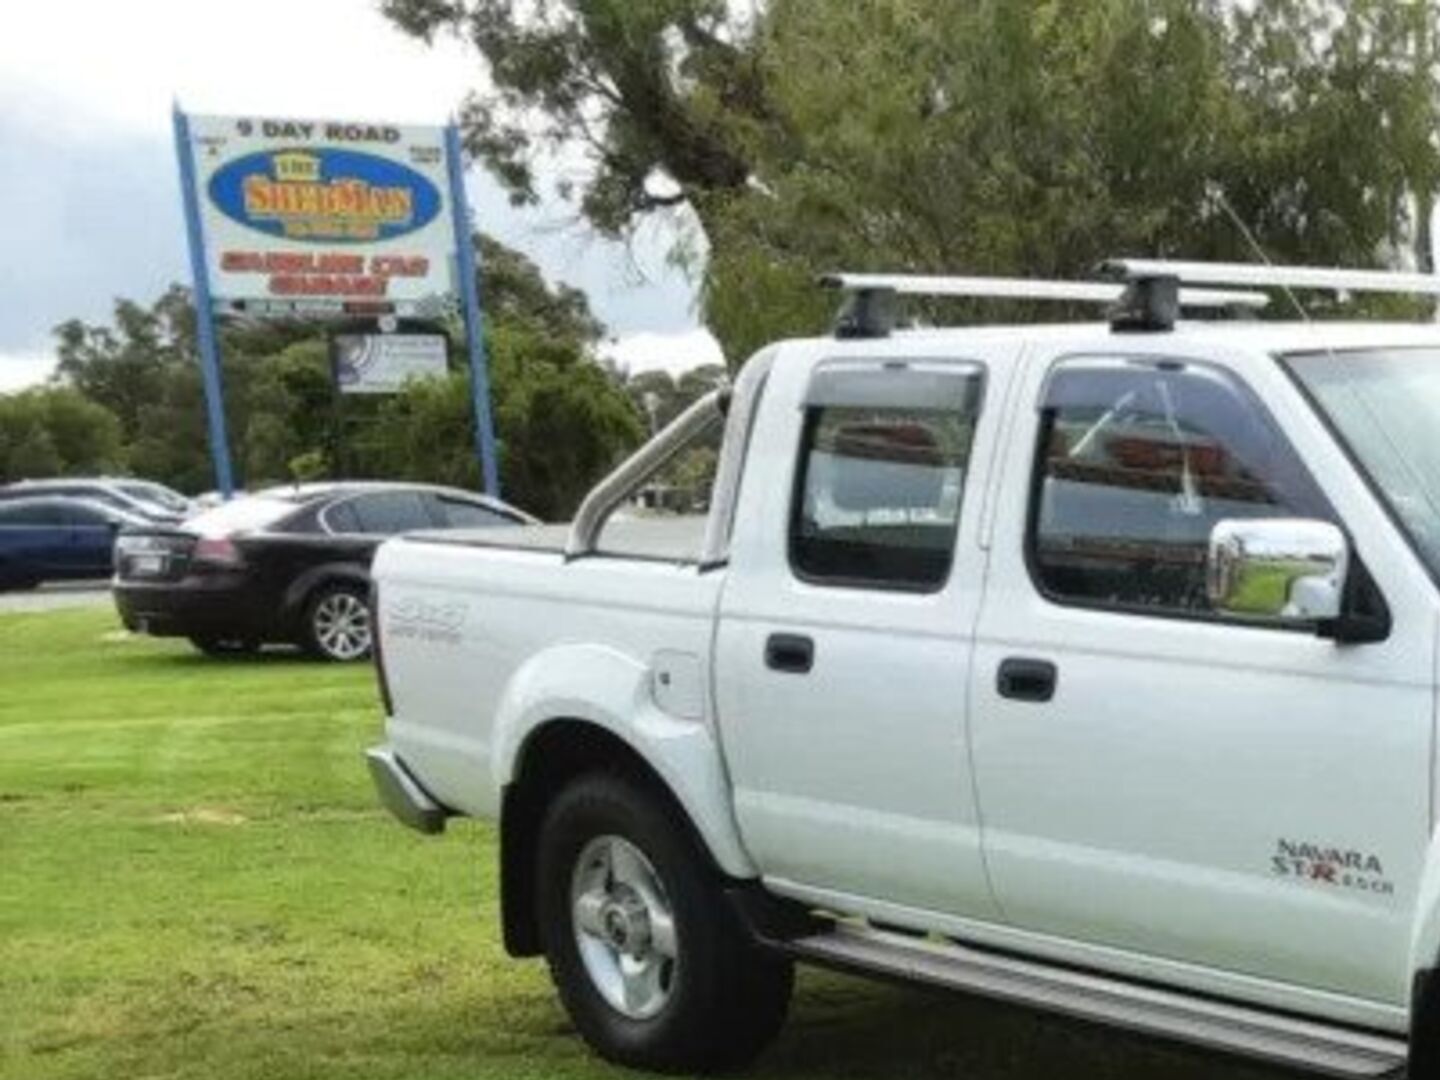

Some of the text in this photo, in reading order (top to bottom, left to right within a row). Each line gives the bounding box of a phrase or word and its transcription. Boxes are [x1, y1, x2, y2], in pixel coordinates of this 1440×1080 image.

[237, 119, 401, 143] 9 DAY ROAD
[1277, 837, 1383, 875] NAVARA
